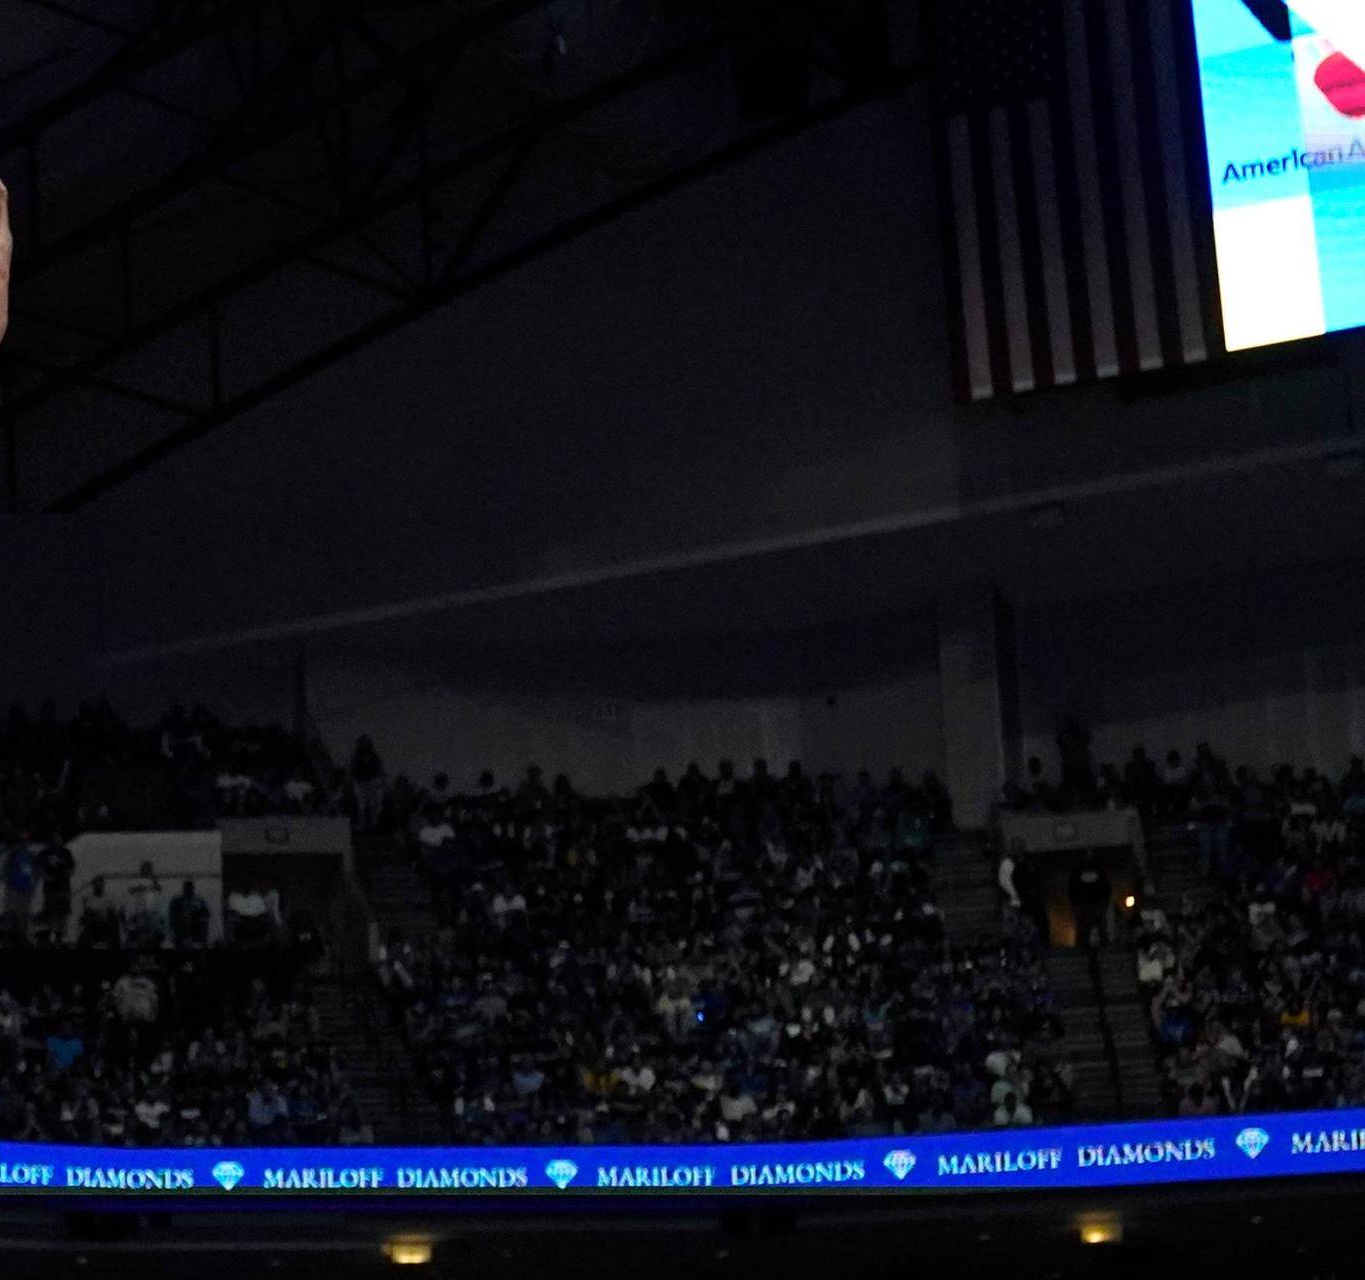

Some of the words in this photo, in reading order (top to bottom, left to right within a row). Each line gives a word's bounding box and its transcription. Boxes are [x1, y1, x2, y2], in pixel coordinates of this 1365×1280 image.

[937, 1145, 1063, 1177] MARILOFF
[1077, 1136, 1217, 1169] DIAMONDS
[66, 1166, 195, 1190] DIAMONDS
[263, 1167, 384, 1189] MARILOFF
[397, 1167, 529, 1189] DIAMONDS
[597, 1165, 716, 1188] MARILOFF
[731, 1159, 866, 1186] DIAMONDS
